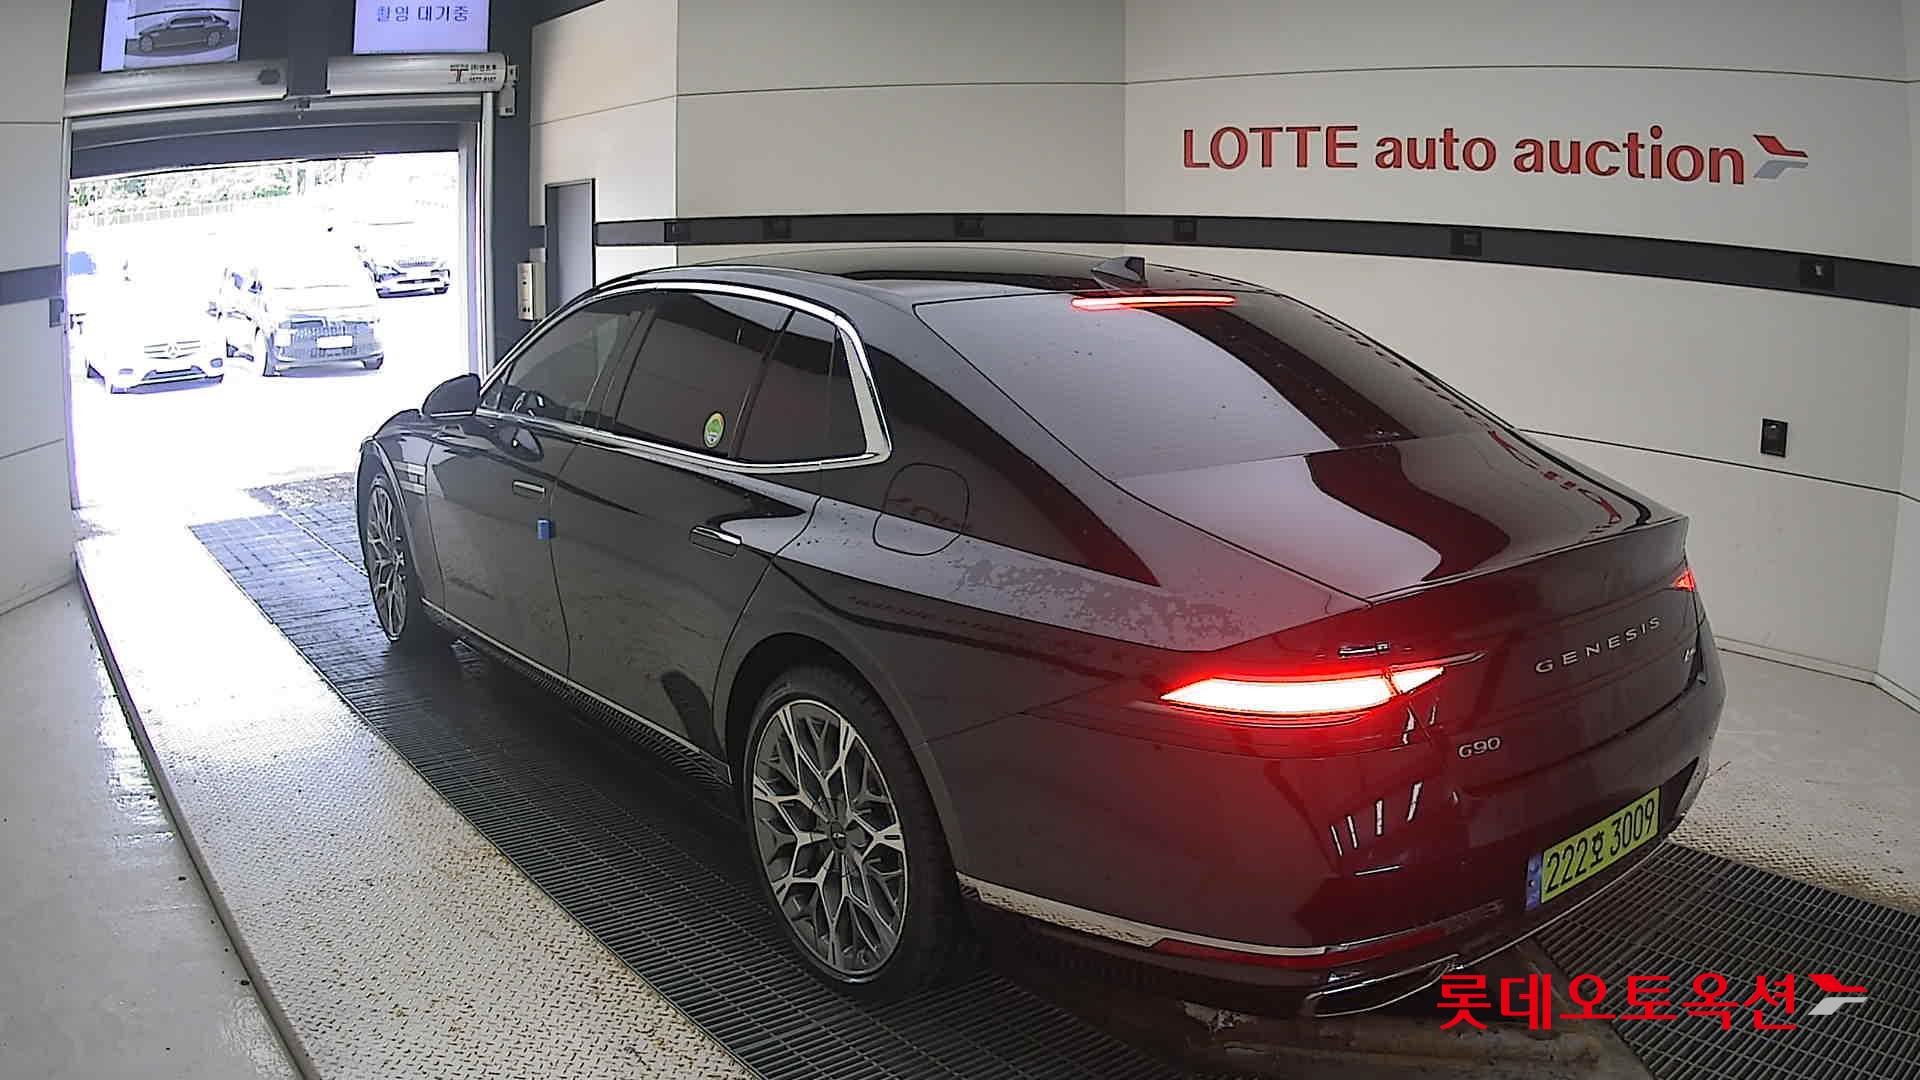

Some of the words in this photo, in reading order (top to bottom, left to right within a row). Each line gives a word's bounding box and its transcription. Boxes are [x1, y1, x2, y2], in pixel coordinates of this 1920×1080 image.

[417, 5, 470, 22] 대기중
[1183, 125, 1358, 169] LOTTE
[1375, 127, 1496, 171] auto
[1513, 125, 1745, 184] auction
[1535, 616, 1662, 674] GENESIS
[1458, 736, 1501, 759] G90
[1610, 798, 1655, 857] 3009
